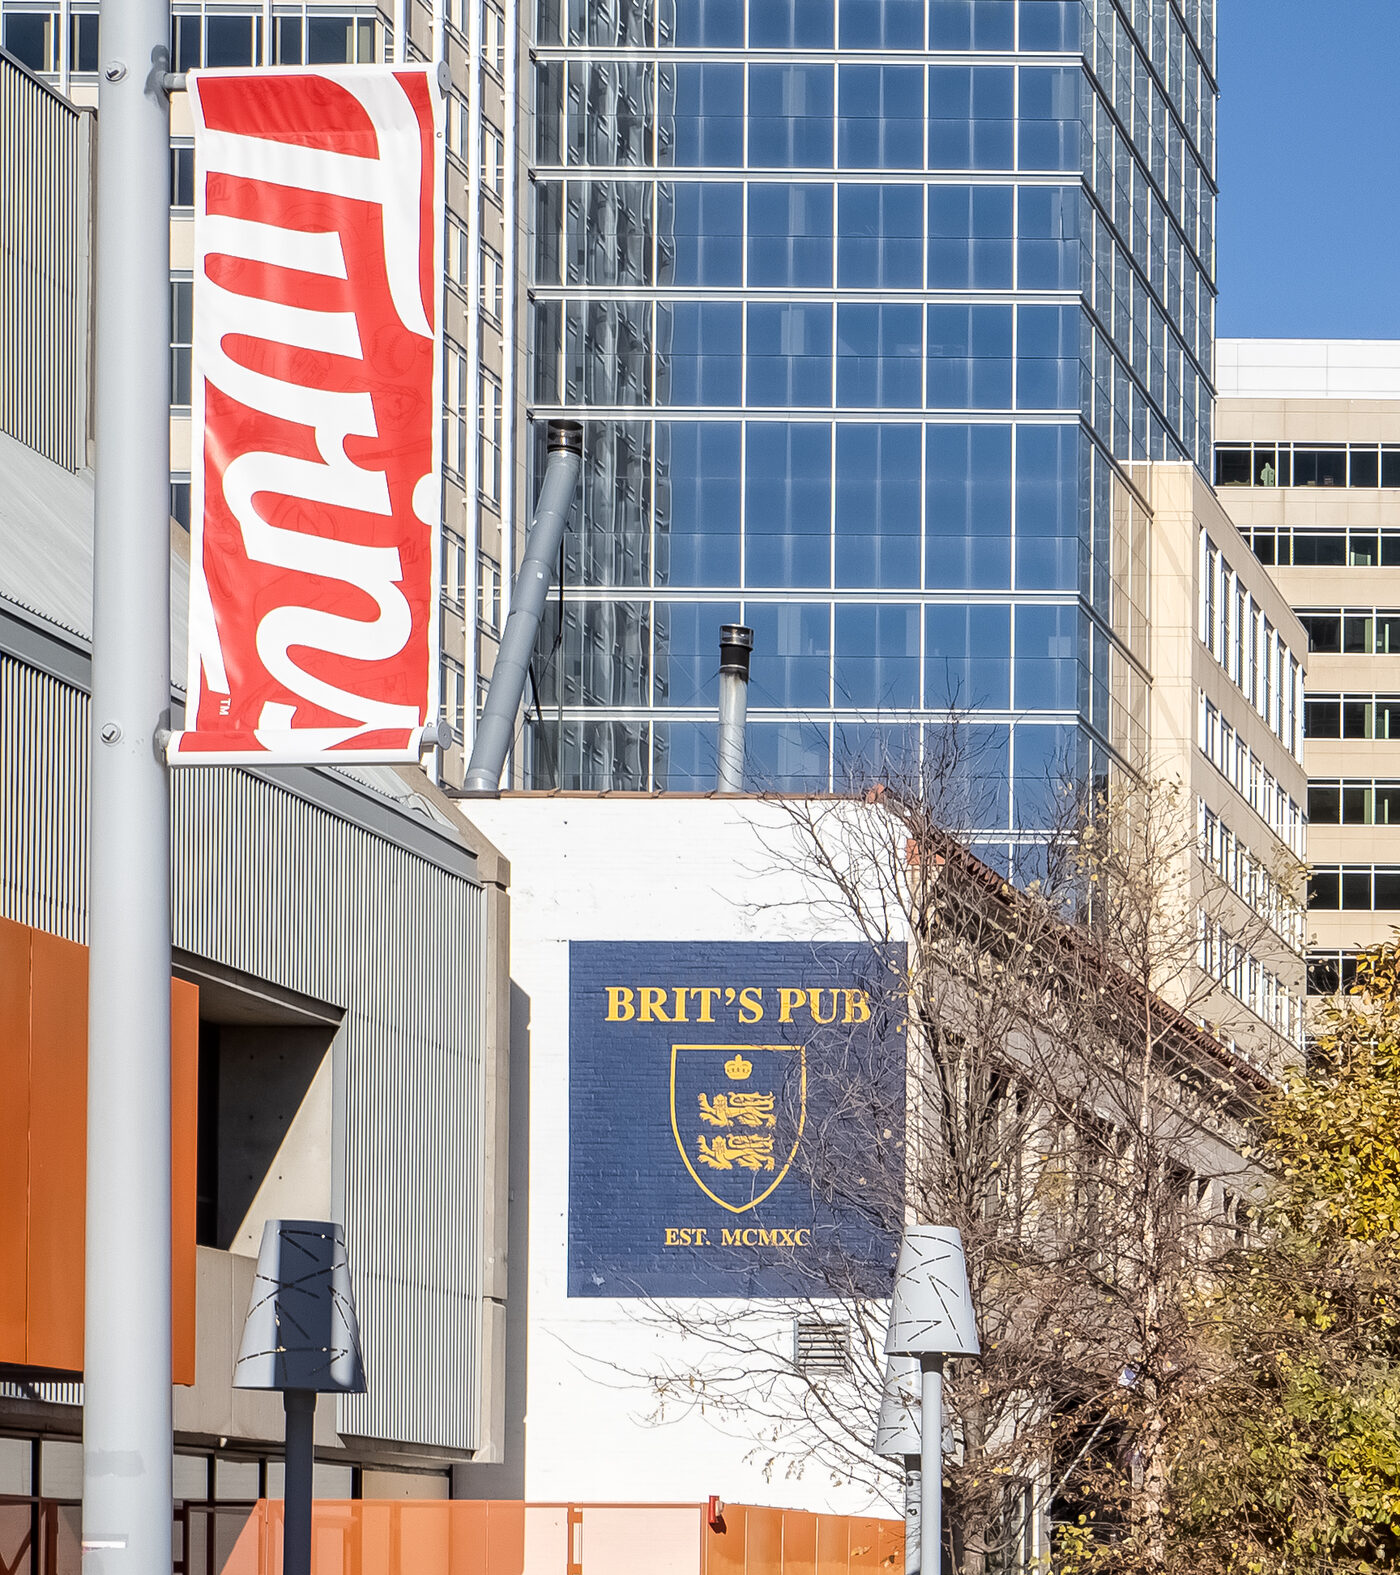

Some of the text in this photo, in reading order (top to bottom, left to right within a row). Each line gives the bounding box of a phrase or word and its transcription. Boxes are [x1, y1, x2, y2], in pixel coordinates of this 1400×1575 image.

[196, 70, 436, 752] Twins
[604, 986, 871, 1024] BRIT'S PUB
[664, 1228, 811, 1247] EST. MCMXC
